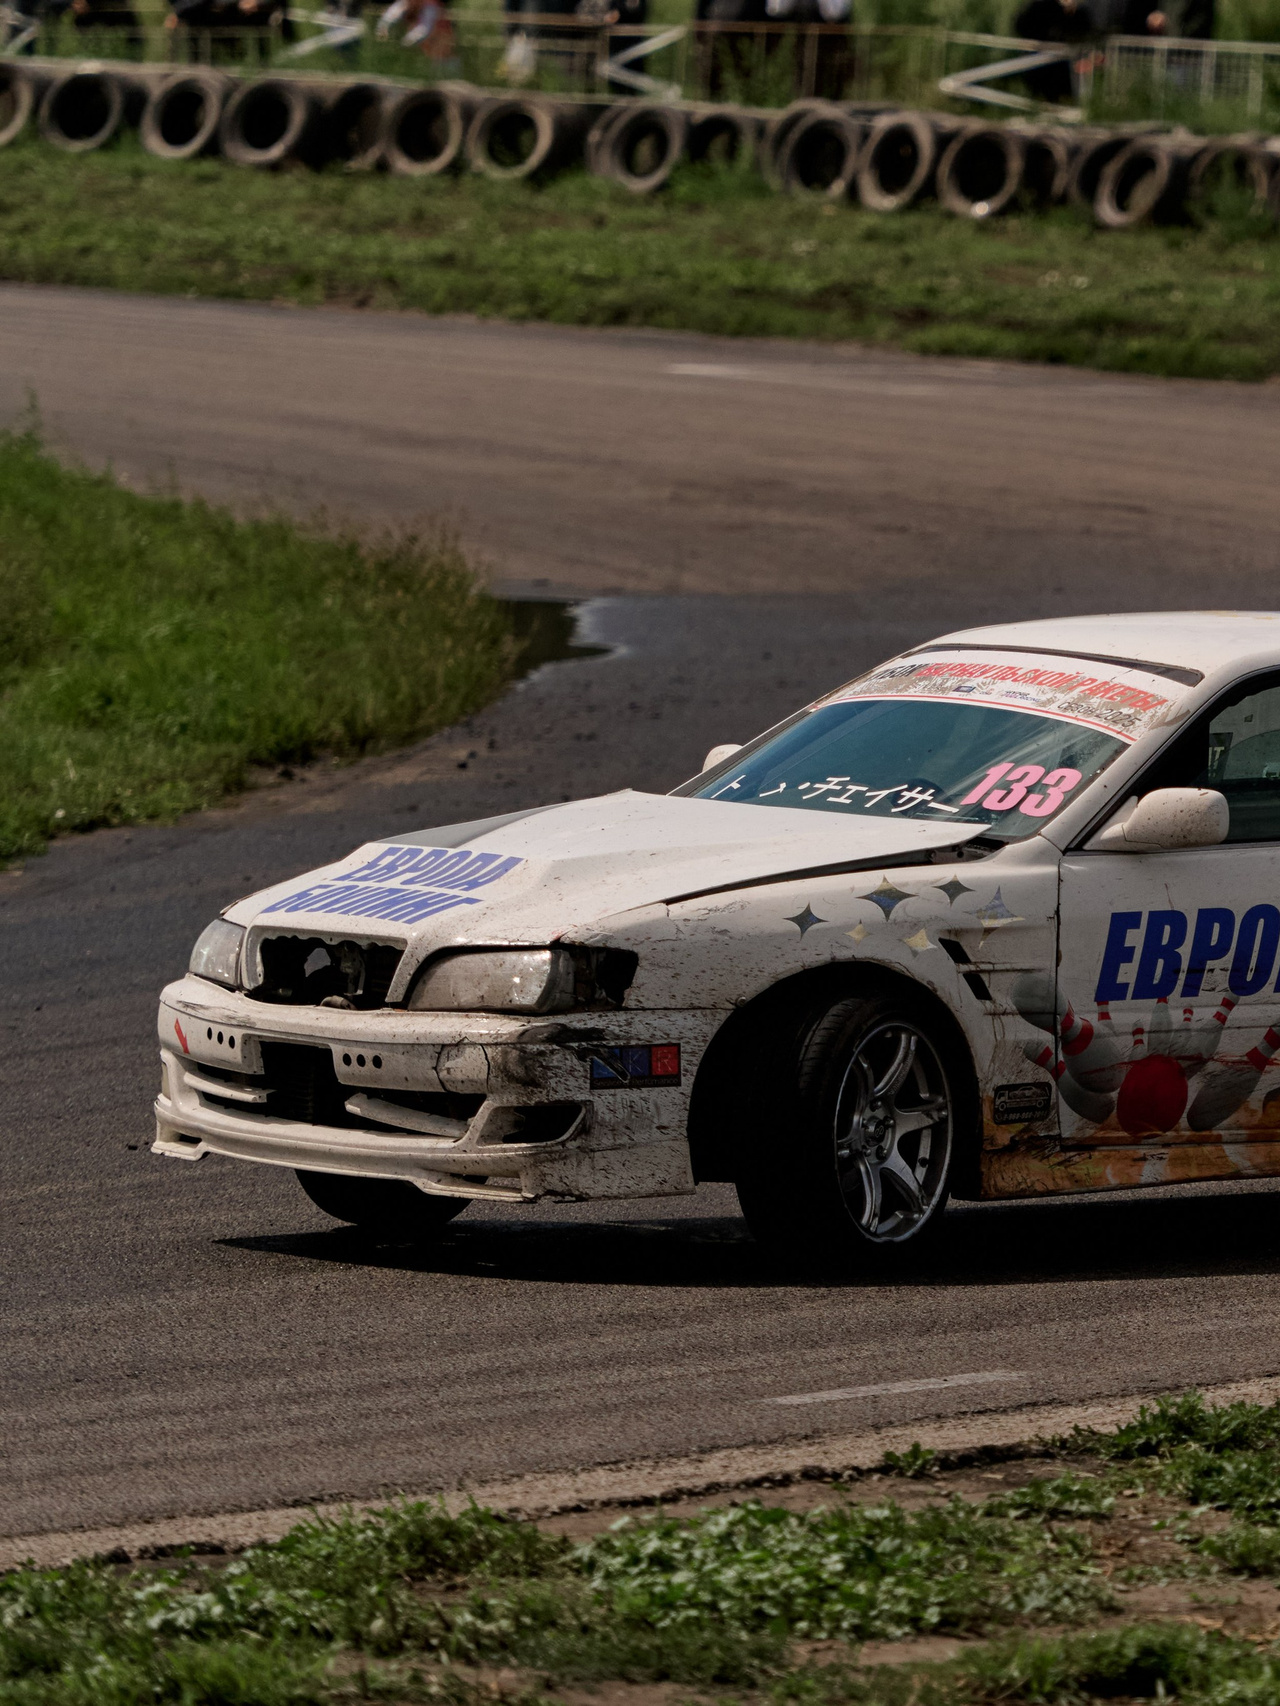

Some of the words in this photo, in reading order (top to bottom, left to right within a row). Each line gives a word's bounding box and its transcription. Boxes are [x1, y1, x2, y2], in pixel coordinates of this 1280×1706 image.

[914, 663, 1084, 689] БАРНАУЛЬСКОЙ
[1067, 677, 1169, 712] РАКЕТЫ
[1094, 708, 1142, 728] 2025
[960, 762, 1083, 818] 133
[329, 846, 524, 892] ЕВРОПА
[261, 884, 484, 925] БОУЛИНГ
